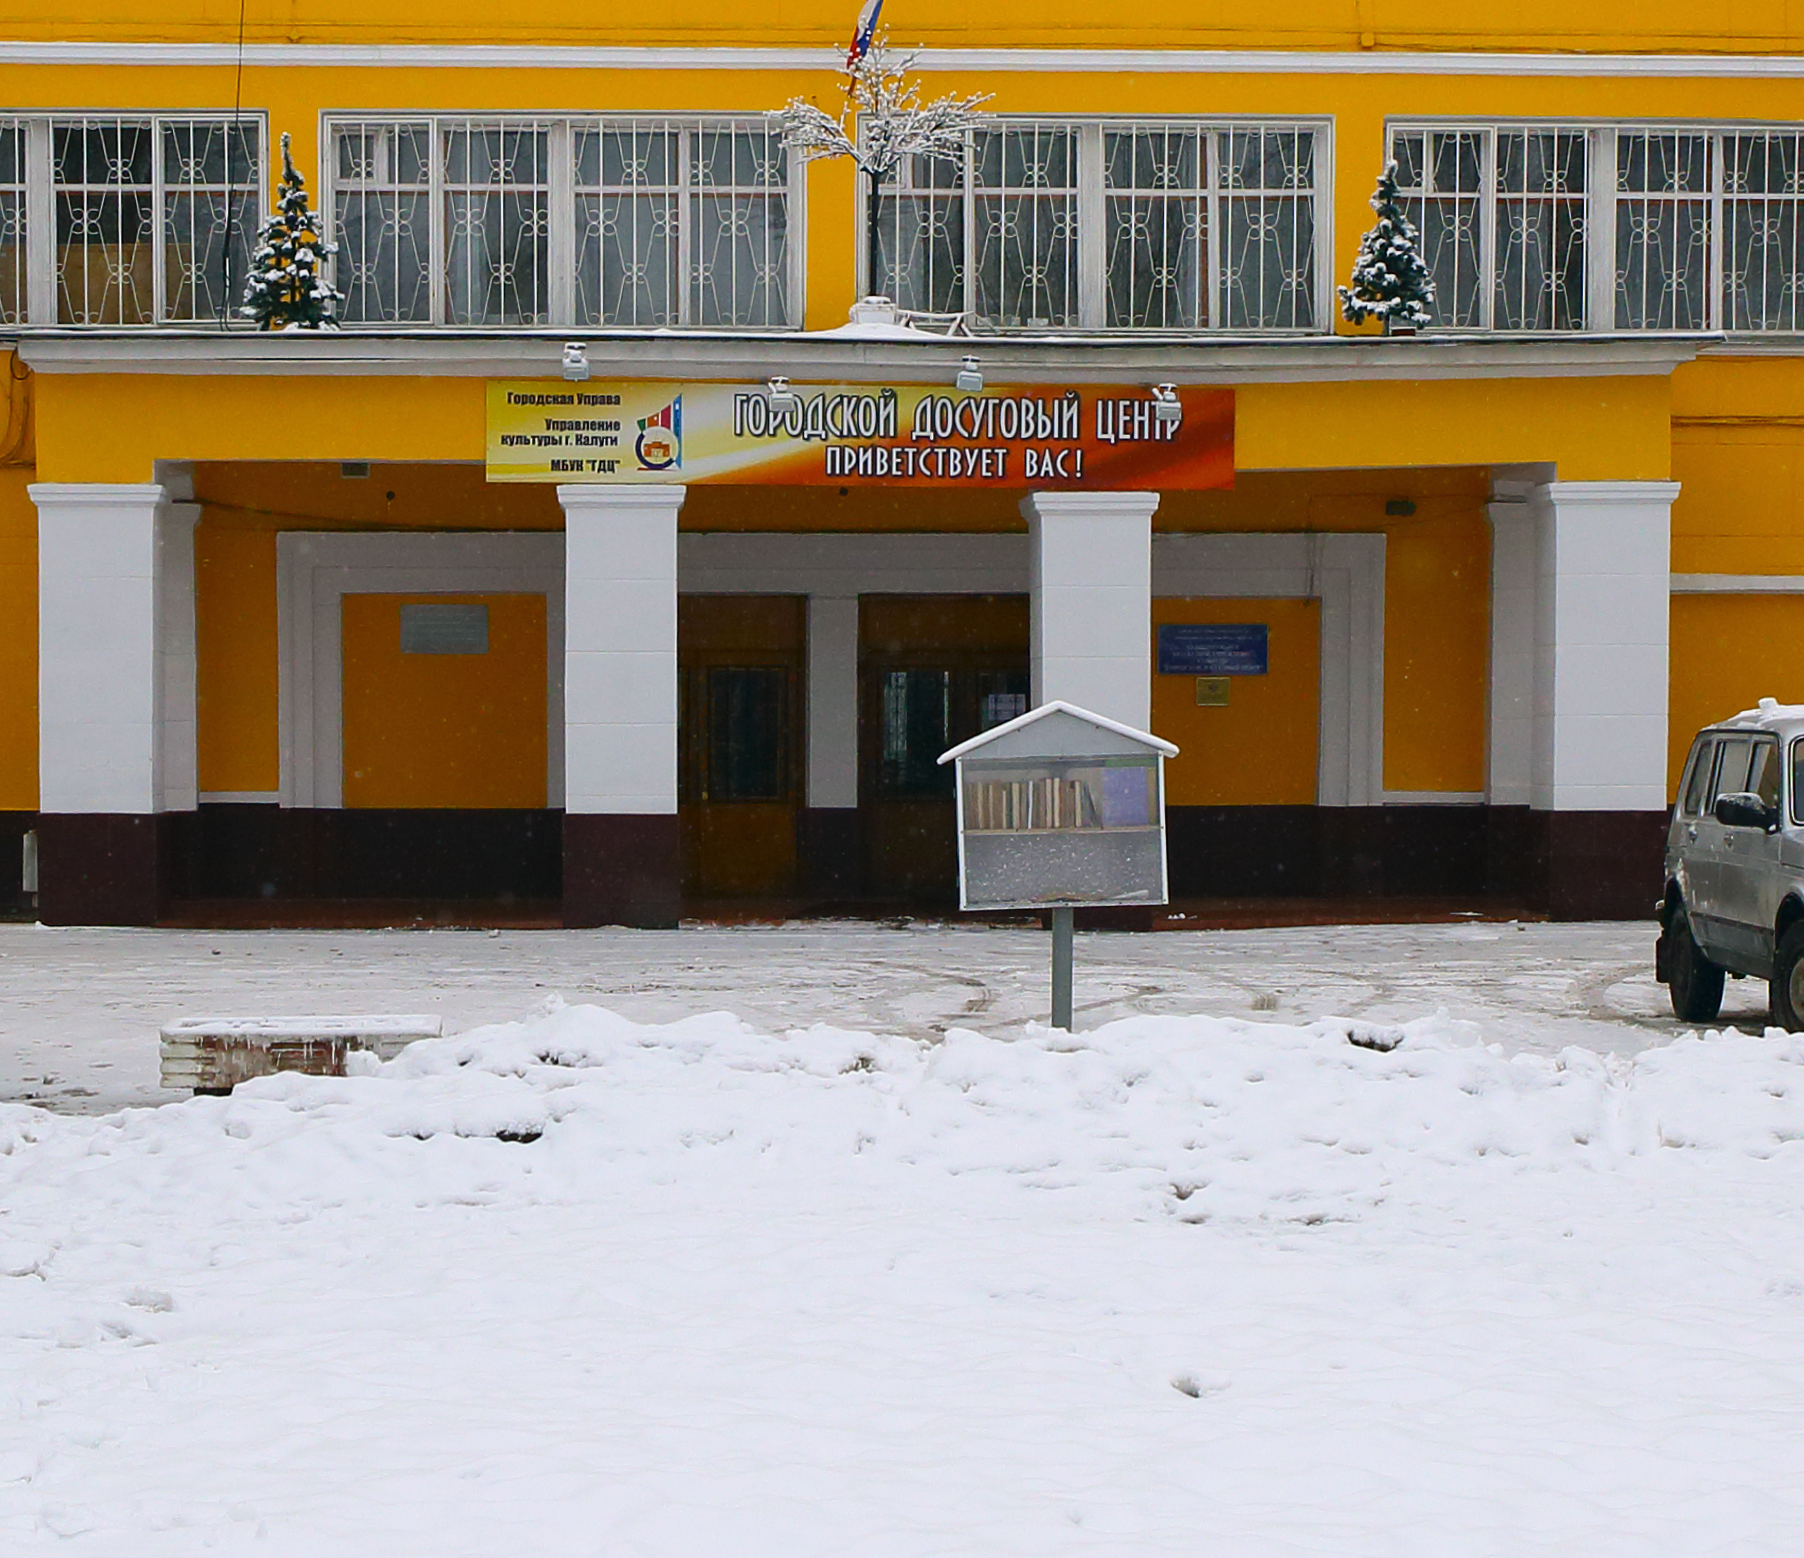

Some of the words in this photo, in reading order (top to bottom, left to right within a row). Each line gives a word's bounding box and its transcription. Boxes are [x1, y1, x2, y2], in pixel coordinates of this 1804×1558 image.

[507, 392, 574, 405] Городская
[577, 392, 621, 406] Управа
[734, 388, 896, 440] ГОРОДСКОЙ
[911, 390, 1079, 440] ДОСУГОВЫЙ
[545, 418, 621, 431] Управление
[500, 434, 562, 446] культуры
[575, 433, 618, 447] Калуги
[550, 459, 583, 472] МБУК
[826, 446, 1007, 477] ПРИВЕТСТВУЕТ
[1024, 448, 1083, 478] ВАС!
